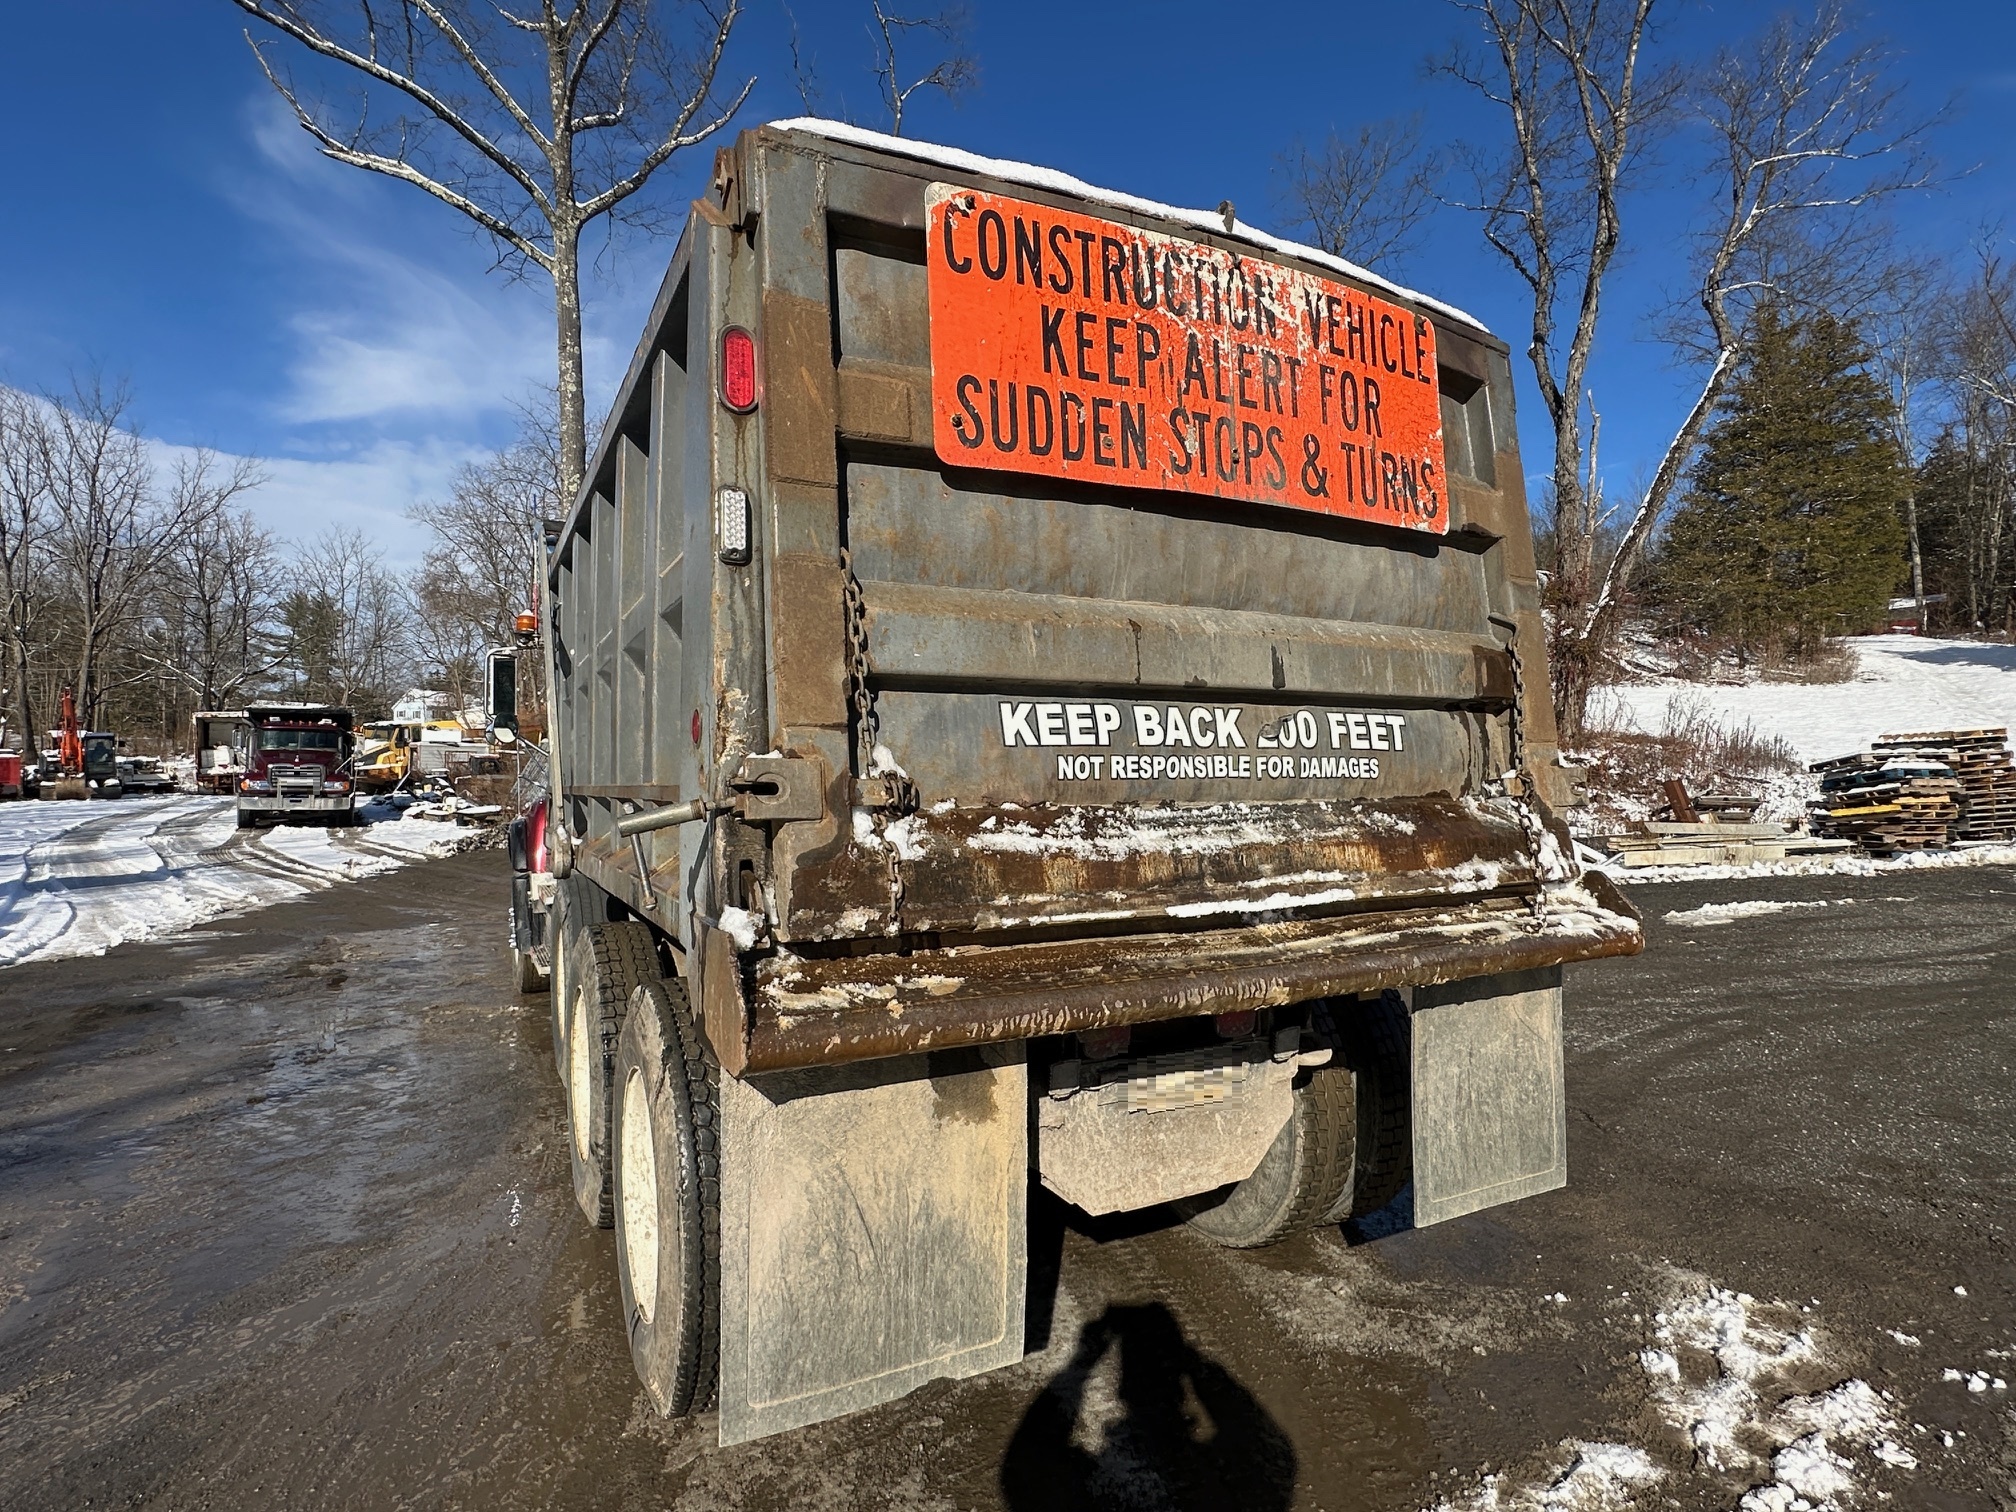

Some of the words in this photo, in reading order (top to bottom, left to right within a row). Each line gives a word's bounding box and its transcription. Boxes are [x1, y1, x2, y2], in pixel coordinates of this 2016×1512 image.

[1041, 304, 1160, 388] KEEP
[1183, 333, 1300, 418] ALERT
[1319, 365, 1382, 438] FOR
[1303, 293, 1432, 385] VEHICLE
[956, 375, 1147, 470] SUDDEN
[1169, 406, 1286, 490] STOPS
[1301, 434, 1329, 498] &
[1341, 441, 1439, 519] TURNS
[1000, 702, 1122, 747] KEEP
[1132, 706, 1246, 749] BACK
[1326, 712, 1406, 751] FEET
[1057, 756, 1105, 780] NOT
[1110, 755, 1251, 780] RESPONSIBLE
[1256, 755, 1295, 780] FOR
[1300, 756, 1380, 780] DAMAGES
